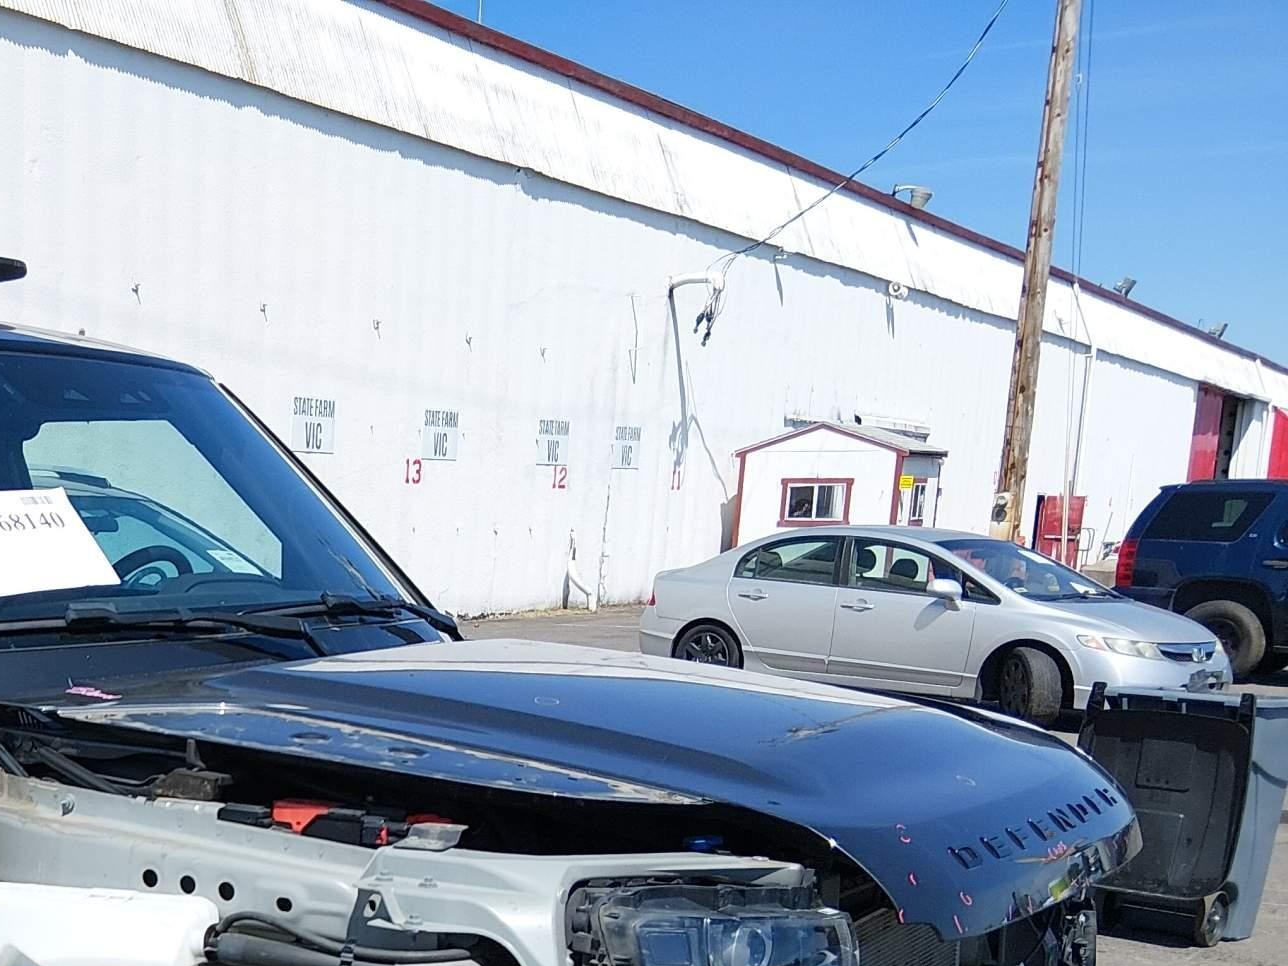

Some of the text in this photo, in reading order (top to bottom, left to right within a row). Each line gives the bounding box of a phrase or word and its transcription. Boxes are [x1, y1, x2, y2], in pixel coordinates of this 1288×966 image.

[293, 397, 336, 419] STATE FARM
[424, 409, 459, 428] STATE FARM
[305, 421, 323, 450] VIC
[538, 419, 570, 436] STATE FARM
[433, 433, 448, 457] VIC
[547, 439, 559, 463] VIC
[621, 445, 633, 467] VIC
[404, 458, 423, 485] 13
[552, 466, 569, 490] 12
